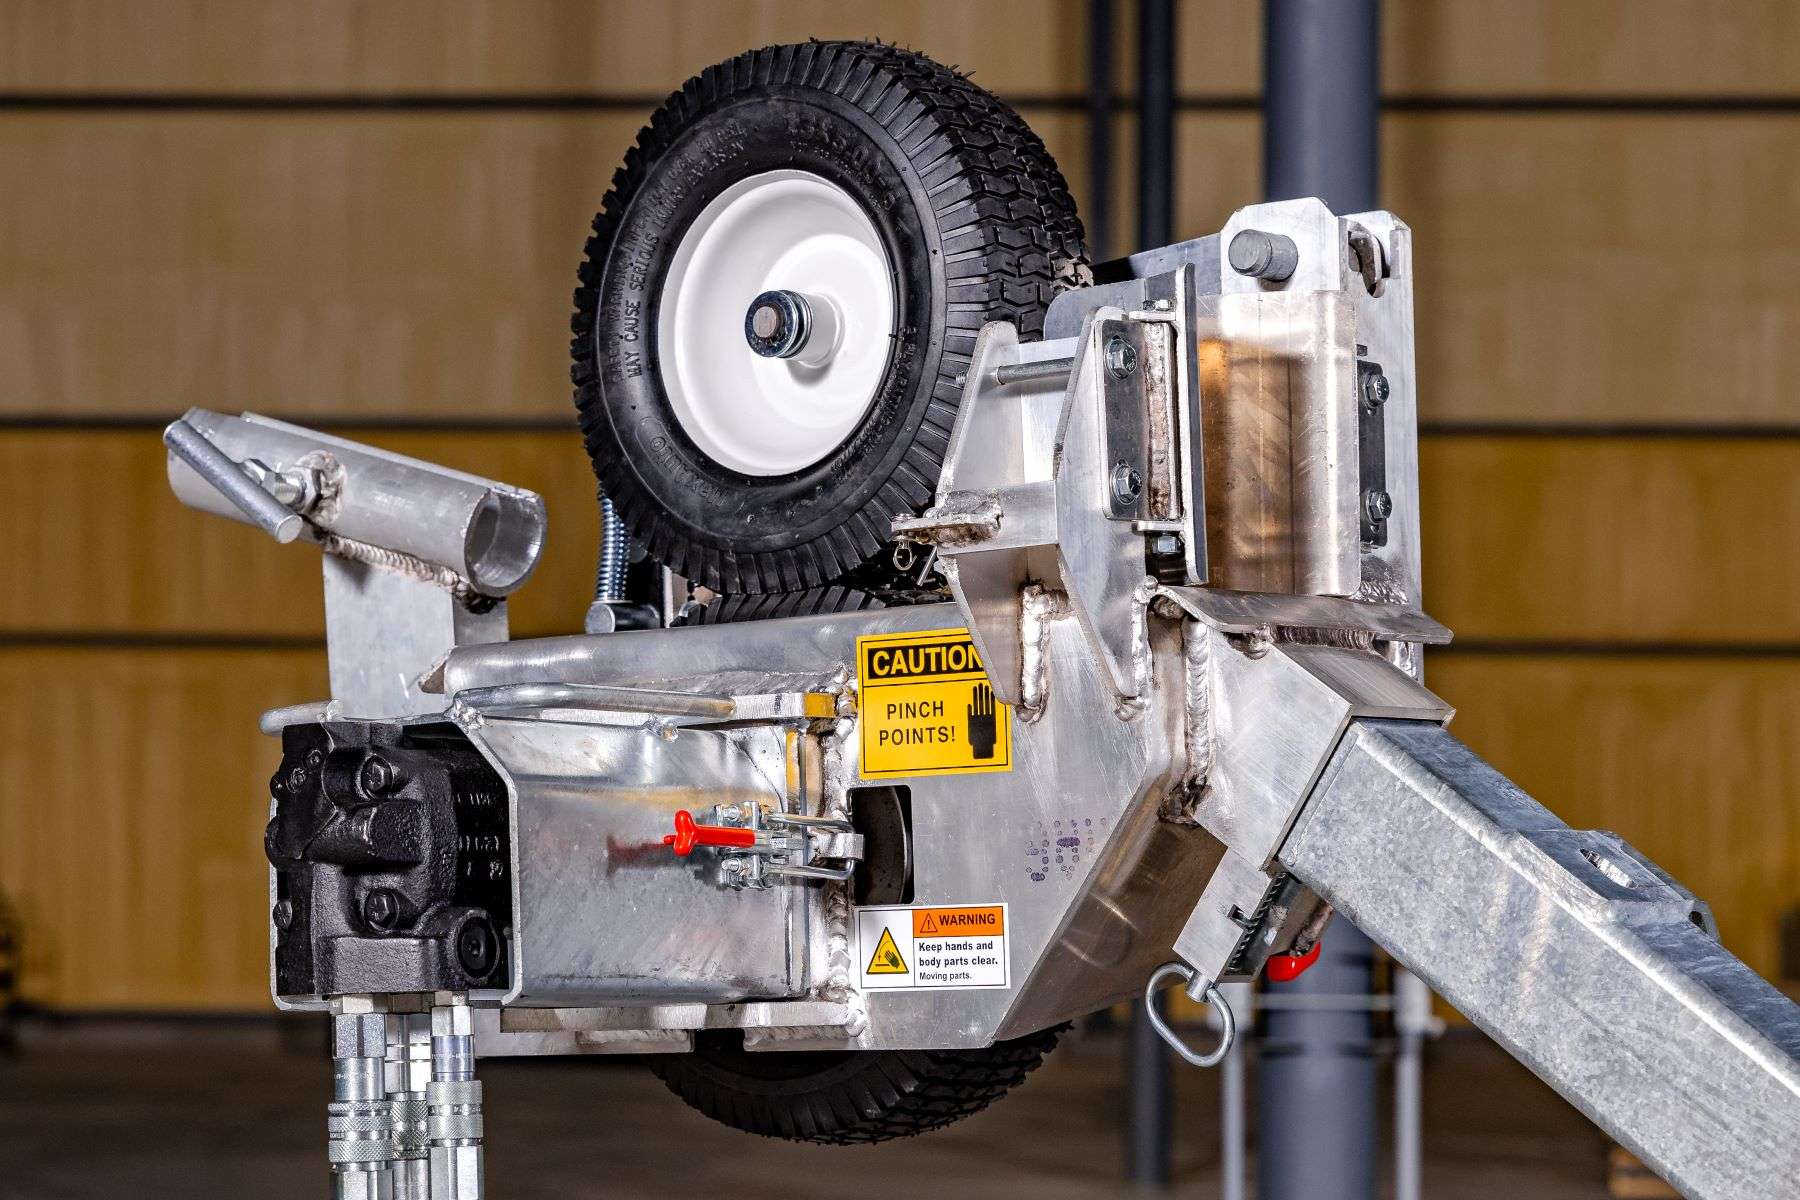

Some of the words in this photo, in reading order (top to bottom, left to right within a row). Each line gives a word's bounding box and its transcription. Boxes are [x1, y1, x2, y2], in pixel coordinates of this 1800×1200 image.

[629, 232, 659, 291] SERIOUS
[624, 299, 641, 342] CAUSE
[624, 351, 642, 378] MAY
[872, 644, 983, 676] CAUTION
[886, 700, 944, 720] PINCH
[879, 726, 956, 746] POINTS!
[938, 913, 996, 926] WARNING
[919, 942, 942, 953] Keep
[945, 941, 973, 951] hands
[976, 940, 994, 950] and
[919, 957, 942, 968] body
[944, 957, 969, 969] parts
[971, 955, 999, 966] clear.
[919, 972, 948, 982] Moving
[949, 971, 972, 981] parts.
